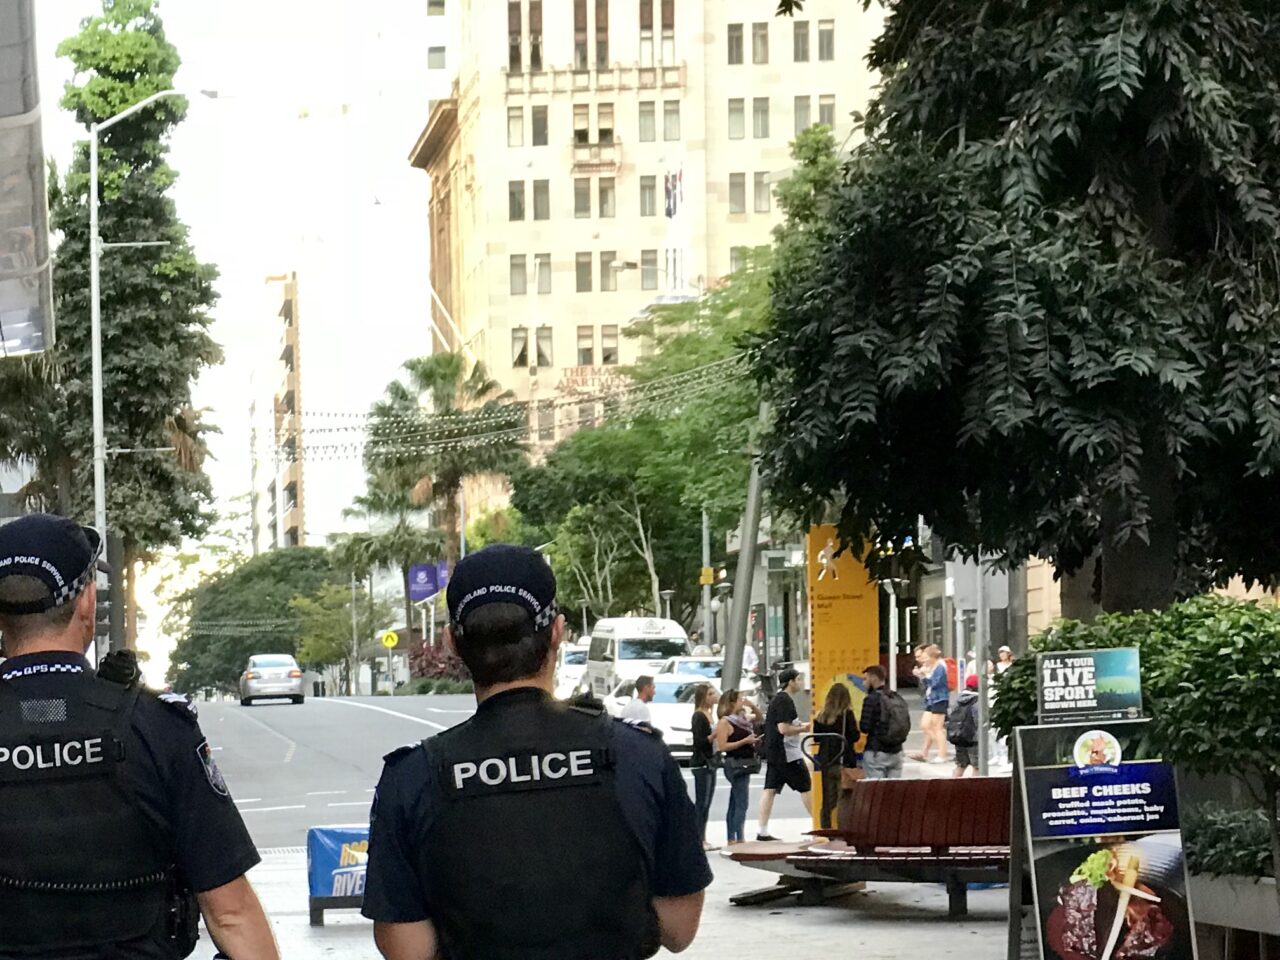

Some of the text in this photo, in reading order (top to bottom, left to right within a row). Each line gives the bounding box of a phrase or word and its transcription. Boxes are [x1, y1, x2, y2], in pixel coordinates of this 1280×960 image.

[14, 556, 41, 565] POLICE
[41, 560, 65, 587] SERVICE
[489, 584, 517, 594] POLICE
[518, 587, 542, 613] SERVICE
[23, 664, 48, 676] QPS
[1043, 657, 1094, 669] ALL YOUR
[1043, 667, 1095, 687] LIVE
[1044, 685, 1096, 701] SPORT
[453, 750, 593, 789] POLICE
[1052, 783, 1151, 799] BEEF CHEEKS
[1144, 805, 1164, 813] baby
[1146, 813, 1160, 821] jus
